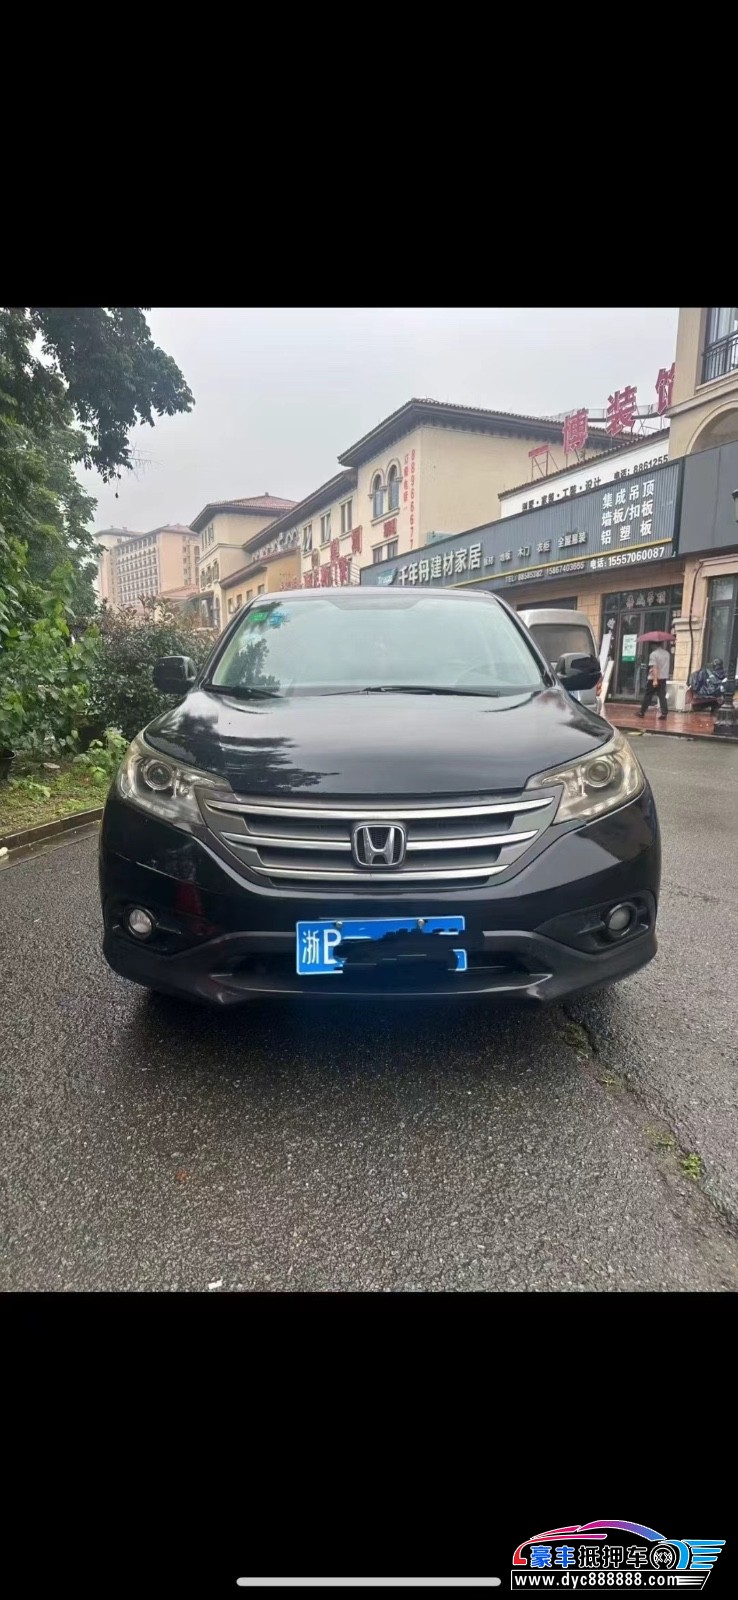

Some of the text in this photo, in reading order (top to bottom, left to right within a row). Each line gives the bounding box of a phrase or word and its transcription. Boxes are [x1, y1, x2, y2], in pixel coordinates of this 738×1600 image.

[602, 480, 655, 509] 集成吊顶
[601, 500, 653, 528] 墙板/扣板
[601, 520, 653, 545] 铝塑板
[399, 543, 481, 586] 千年舟建材家居
